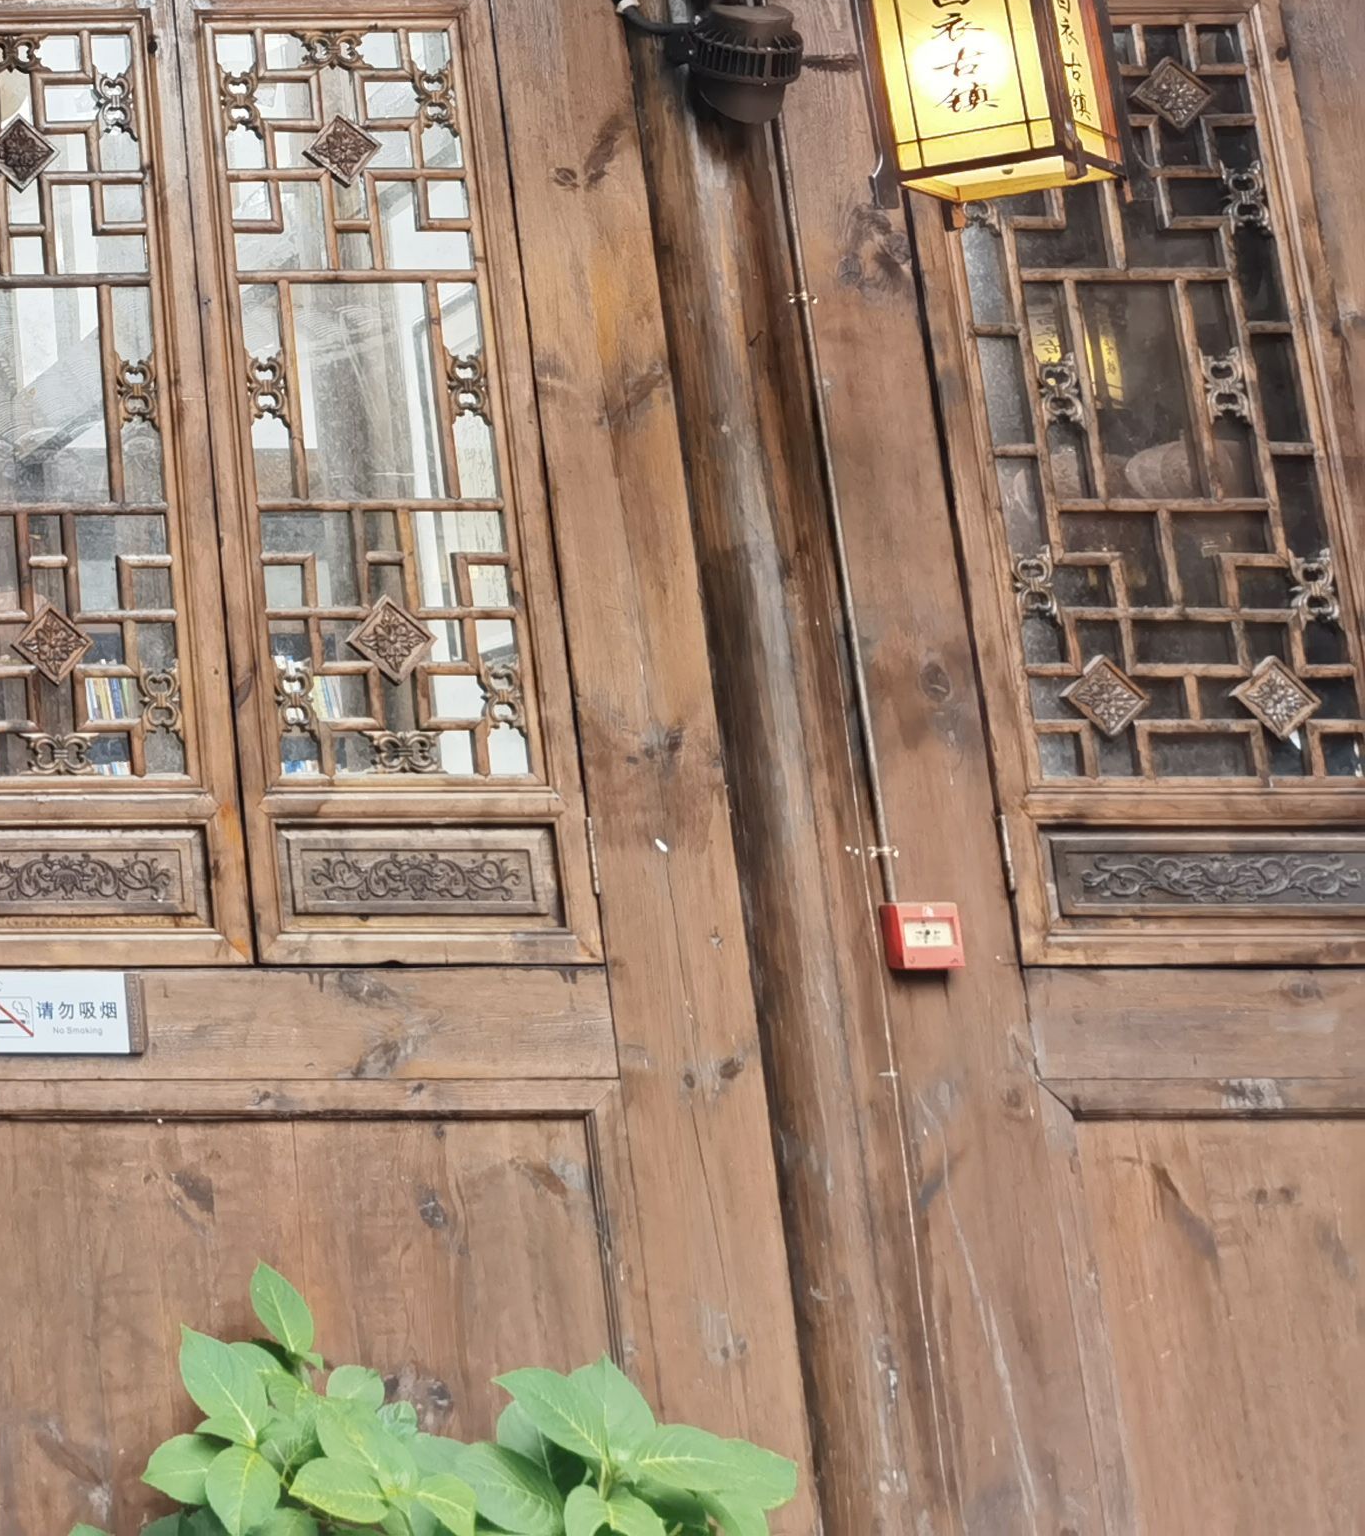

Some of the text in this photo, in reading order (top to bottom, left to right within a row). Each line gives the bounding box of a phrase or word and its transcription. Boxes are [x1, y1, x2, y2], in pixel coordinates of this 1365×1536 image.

[36, 1001, 117, 1020] 请勿吸烟
[53, 1026, 103, 1037] No Smoking
